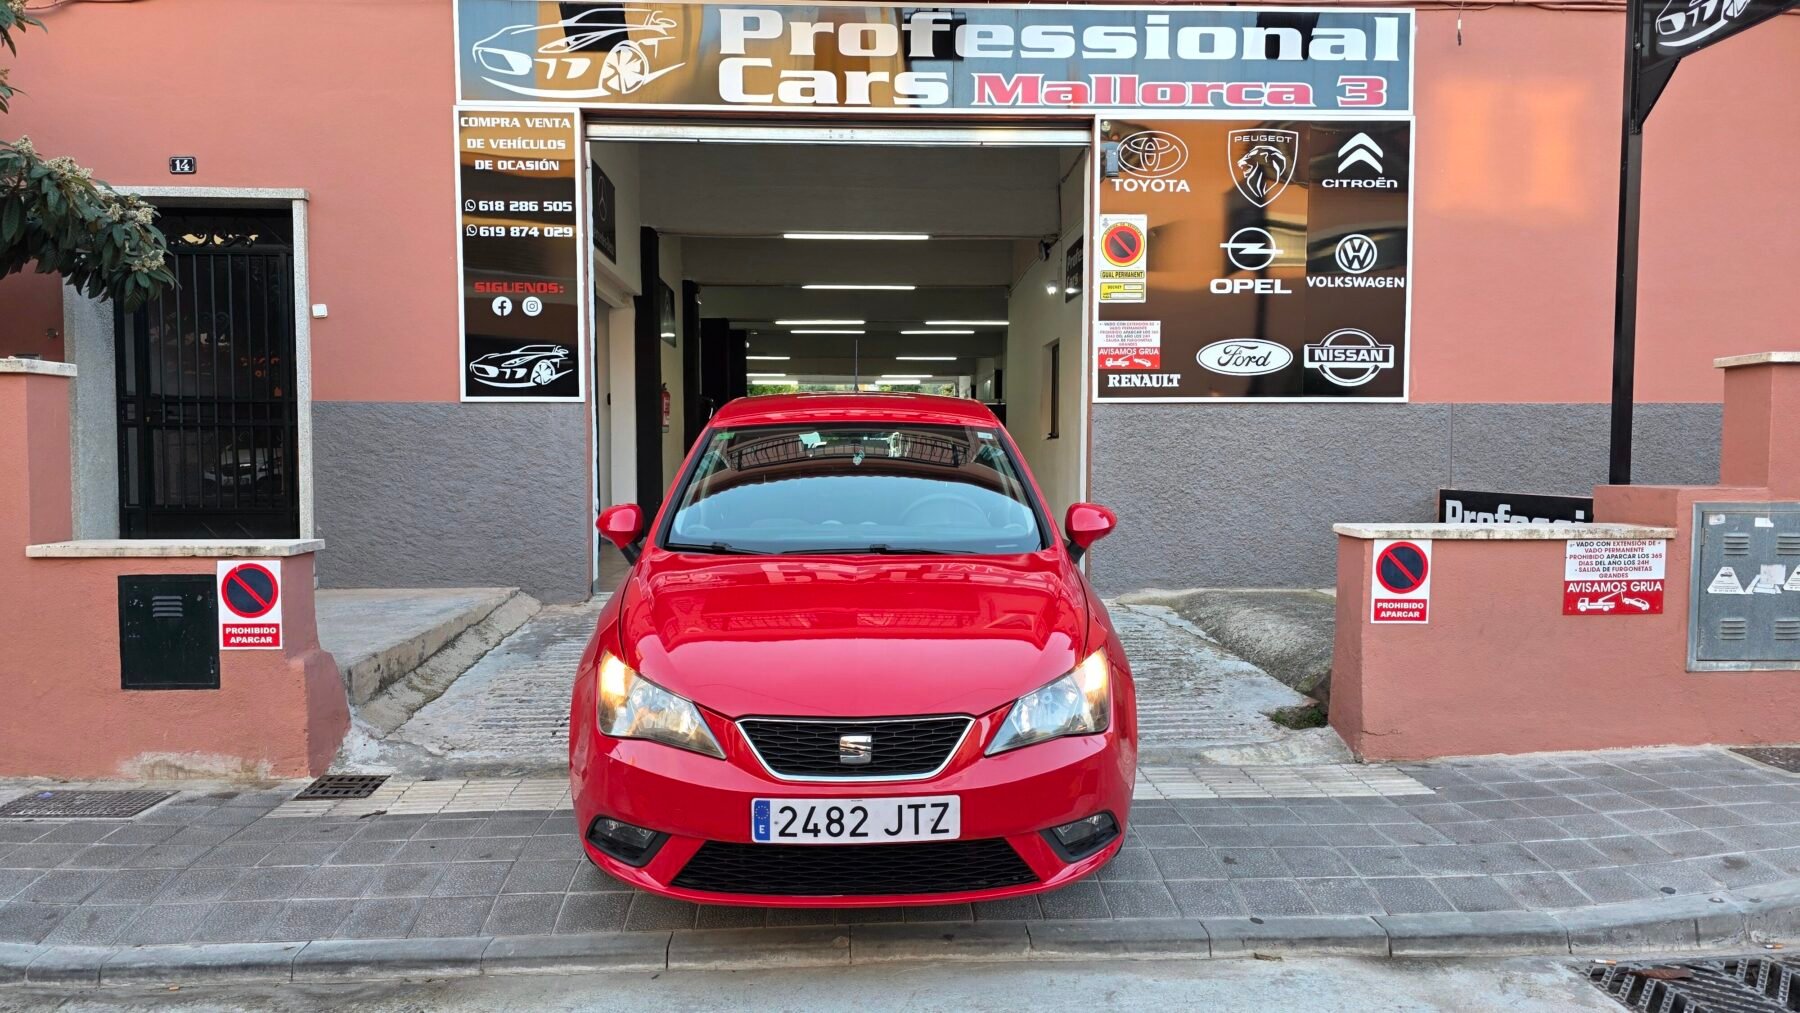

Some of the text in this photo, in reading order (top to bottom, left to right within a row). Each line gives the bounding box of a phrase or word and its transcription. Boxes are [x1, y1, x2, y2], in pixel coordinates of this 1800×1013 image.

[718, 8, 1400, 62] Professional
[718, 57, 1388, 107] Cars Mallorca 3
[460, 116, 571, 128] COMPRA VENTA
[466, 136, 566, 150] DE VEHÍCULOS
[1234, 135, 1293, 144] PEUGEOT
[175, 159, 190, 171] 14
[474, 158, 560, 171] DE OCASIÓN
[1111, 178, 1191, 192] TOYOTA
[478, 200, 573, 212] 618 286 505
[479, 226, 574, 238] 619 874 029
[474, 282, 564, 294] SIGUENOS:
[1210, 278, 1292, 294] OPEL
[1306, 276, 1405, 288] VOLKSWAGEN
[1217, 344, 1272, 367] Ford
[1314, 349, 1384, 362] NISSAN
[1107, 373, 1181, 388] RENAULT
[1567, 582, 1662, 592] AVISAMOS GRUA
[778, 802, 950, 838] 2482 JTZ
[758, 825, 766, 834] E
